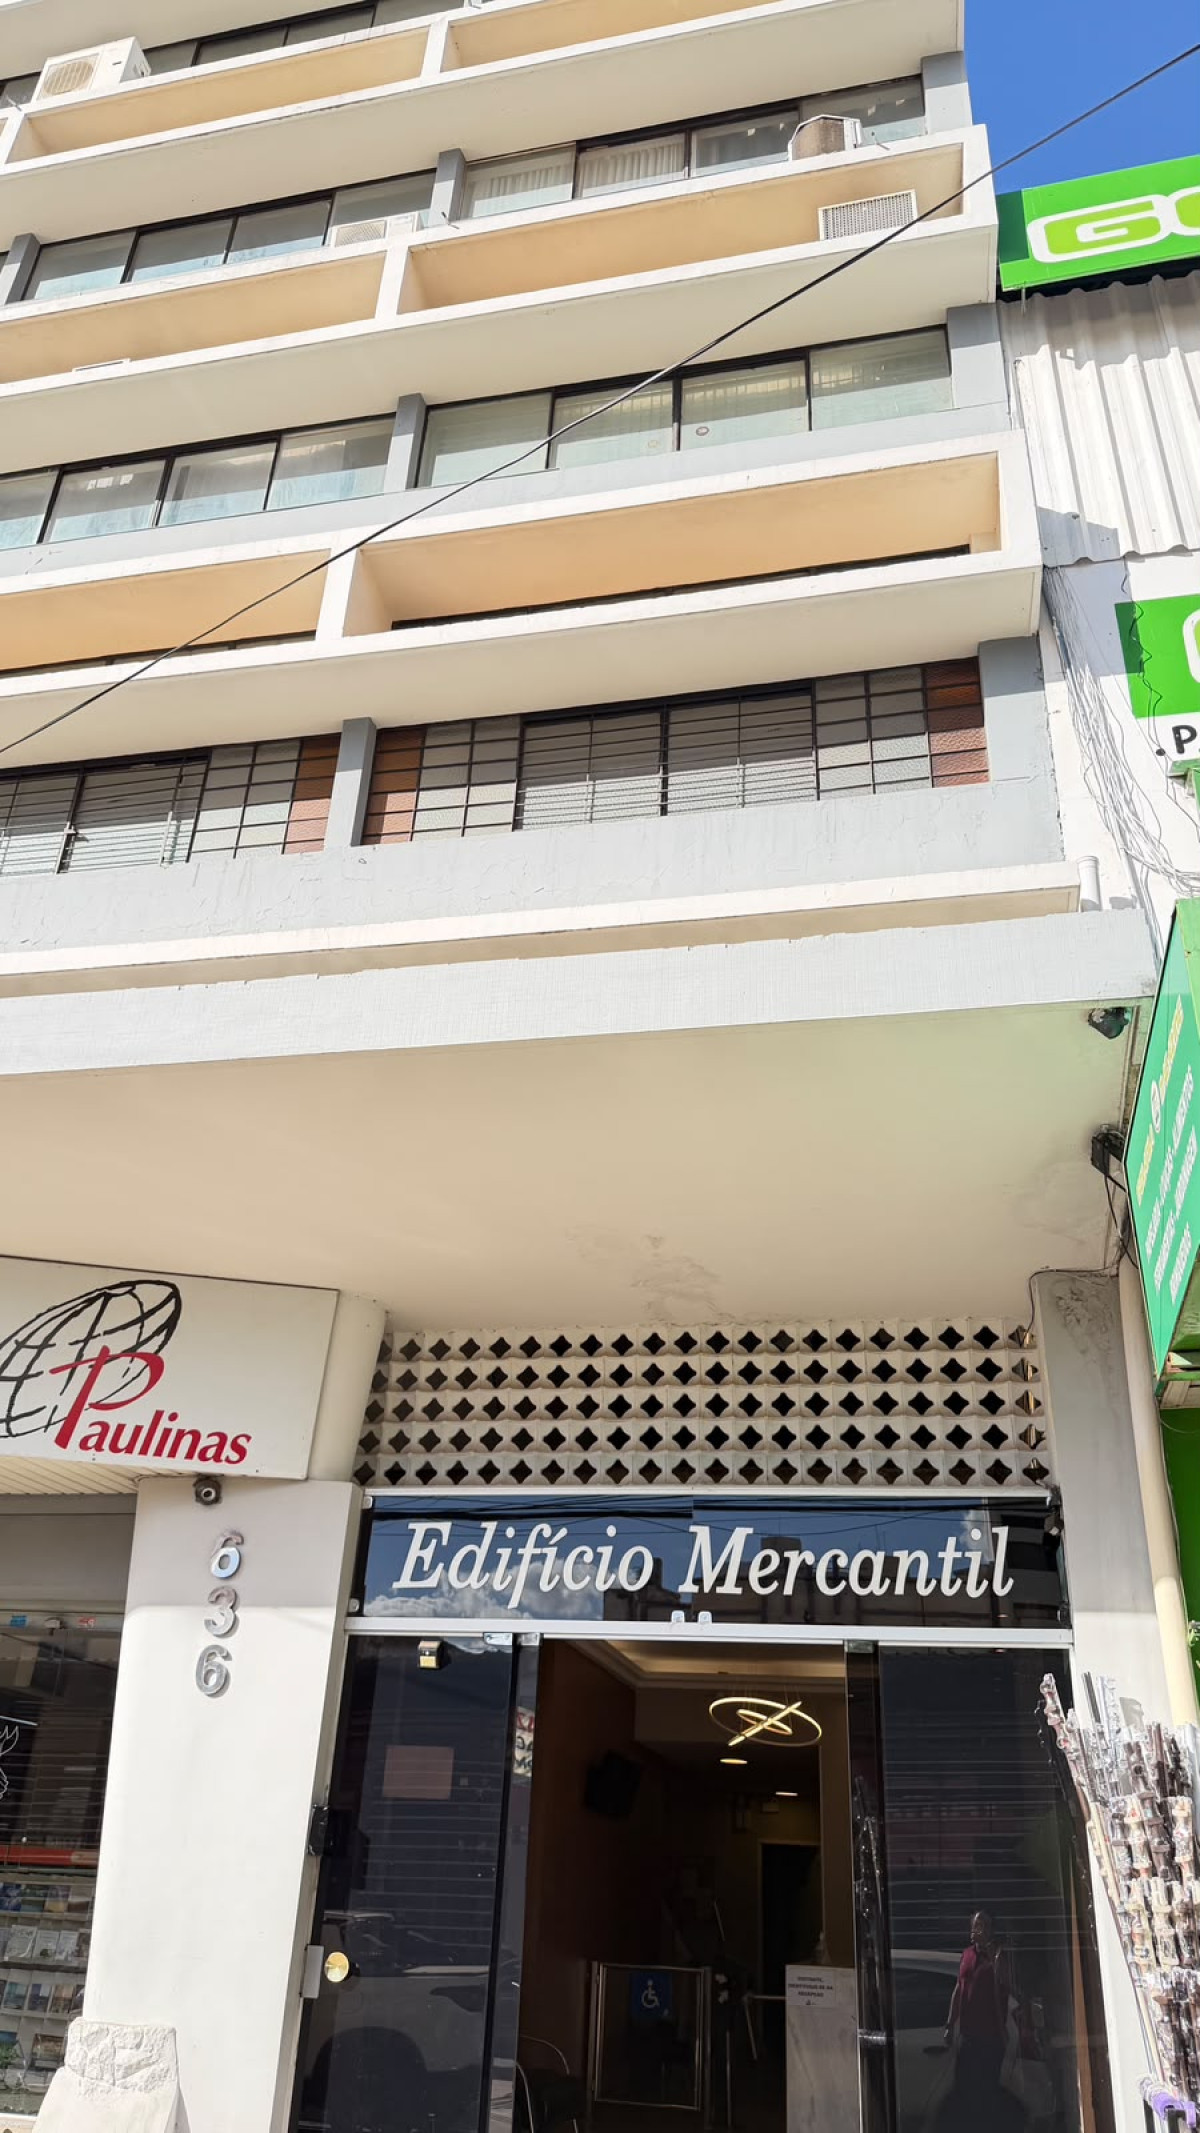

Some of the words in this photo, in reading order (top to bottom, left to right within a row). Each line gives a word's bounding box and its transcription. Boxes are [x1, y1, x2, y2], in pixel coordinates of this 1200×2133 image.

[1027, 186, 1200, 263] G
[49, 1345, 252, 1465] Paulinas
[195, 1529, 246, 1699] 636
[392, 1520, 654, 1610] Edifício
[678, 1525, 1014, 1598] Mercantil
